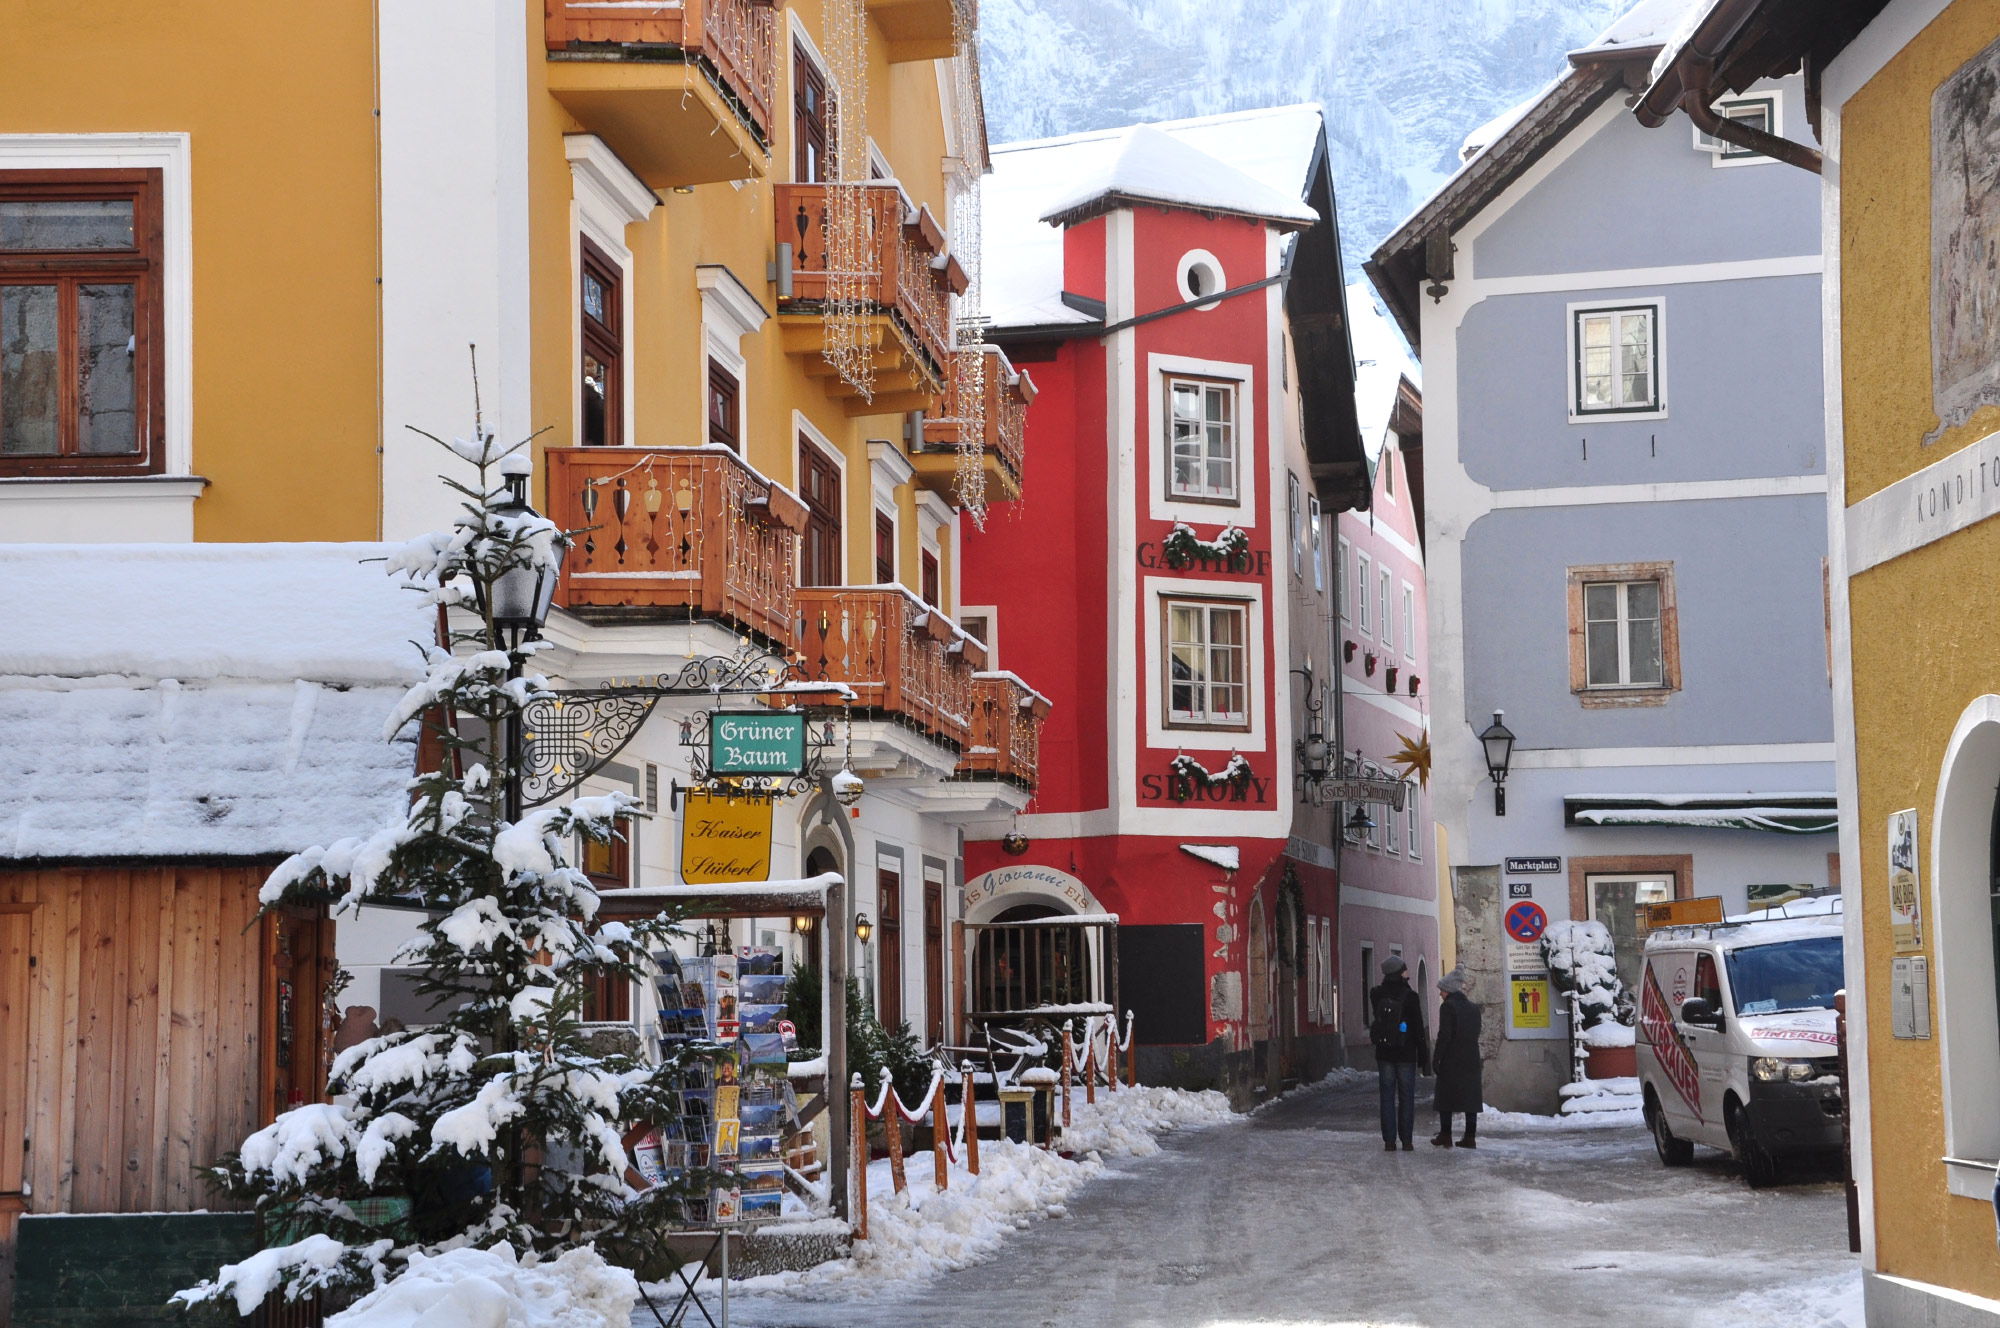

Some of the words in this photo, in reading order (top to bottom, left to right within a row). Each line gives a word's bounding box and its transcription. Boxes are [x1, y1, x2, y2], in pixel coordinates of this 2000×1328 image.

[1917, 456, 2000, 523] KONDITO
[720, 720, 794, 741] Grüner
[724, 747, 788, 766] Baum
[1321, 781, 1363, 800] Gasthof
[1362, 783, 1397, 805] Simony
[691, 819, 763, 839] Kaiser
[685, 856, 763, 876] Stüberl
[1509, 861, 1557, 872] Marktplatz
[964, 889, 981, 911] IS
[983, 870, 1066, 896] Giovanni
[1064, 885, 1089, 909] EIS
[1513, 884, 1527, 894] 60
[1751, 1029, 1837, 1043] WINTERAUE
